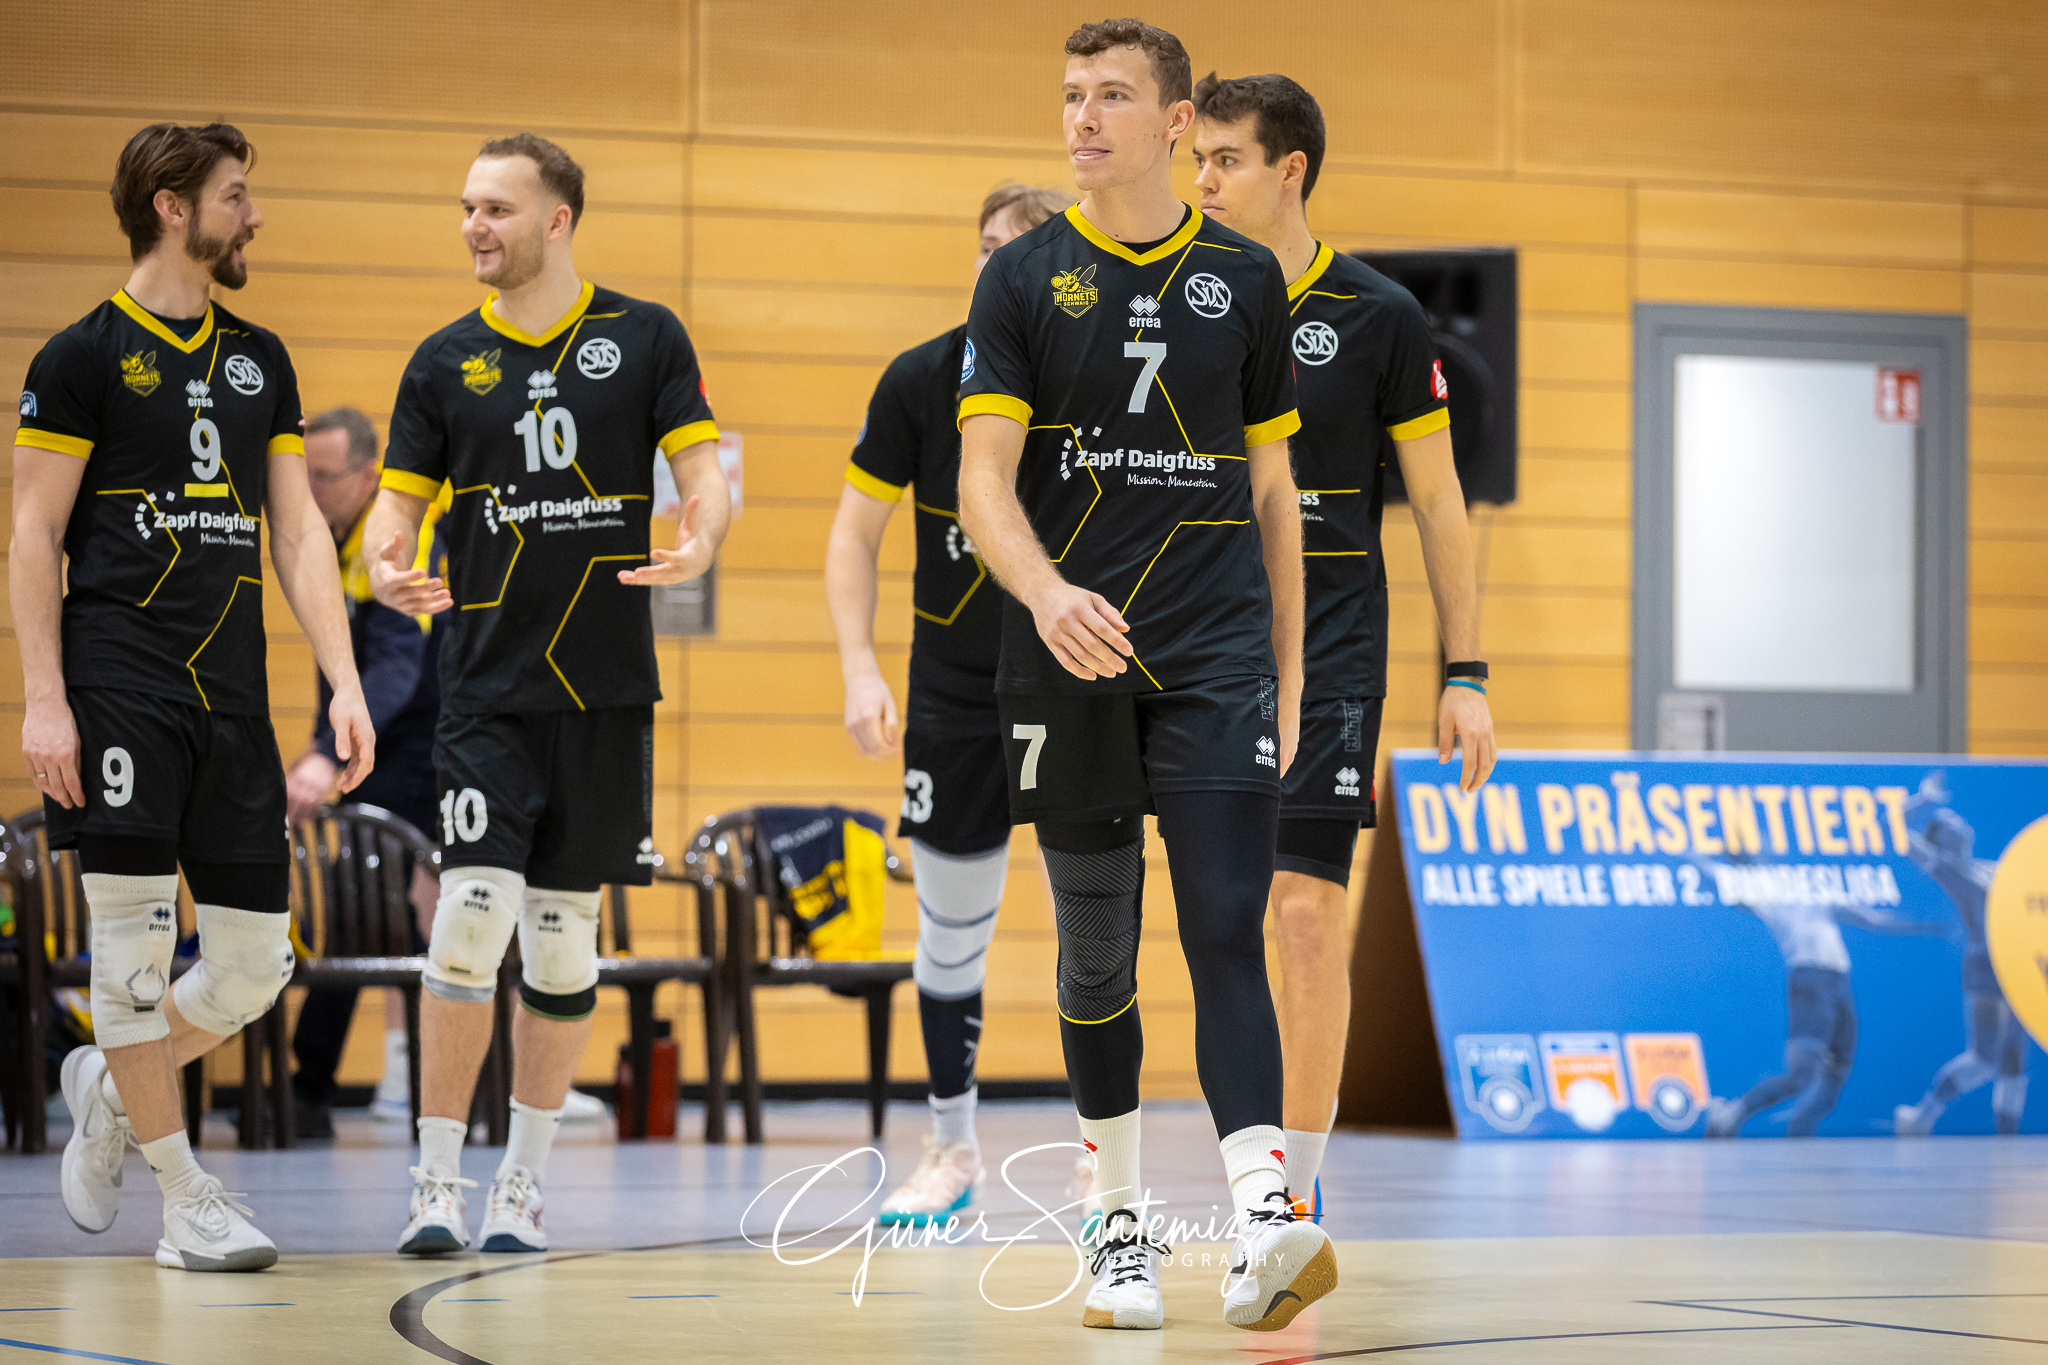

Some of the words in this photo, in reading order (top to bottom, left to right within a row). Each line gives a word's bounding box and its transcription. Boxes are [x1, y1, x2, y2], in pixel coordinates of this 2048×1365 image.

[1056, 291, 1096, 303] HORNETS
[1124, 341, 1167, 413] 7
[189, 417, 221, 482] 9
[514, 406, 578, 473] 10
[1075, 448, 1124, 471] Zapf
[1128, 449, 1216, 473] Daigfuss
[153, 510, 198, 532] Zapf
[199, 511, 256, 533] Daigfuss
[497, 501, 539, 524] Zapf
[540, 496, 623, 518] Daigfuss
[102, 746, 134, 808] 9
[1012, 723, 1047, 791] 7
[439, 787, 488, 847] 10
[1406, 781, 1528, 856] DYN
[1536, 770, 1910, 857] PRÄSENTIERT
[1421, 862, 1499, 906] ALLE
[1500, 862, 1609, 906] SPIELE
[1611, 862, 1677, 906] DER
[1678, 862, 1714, 906] 2.
